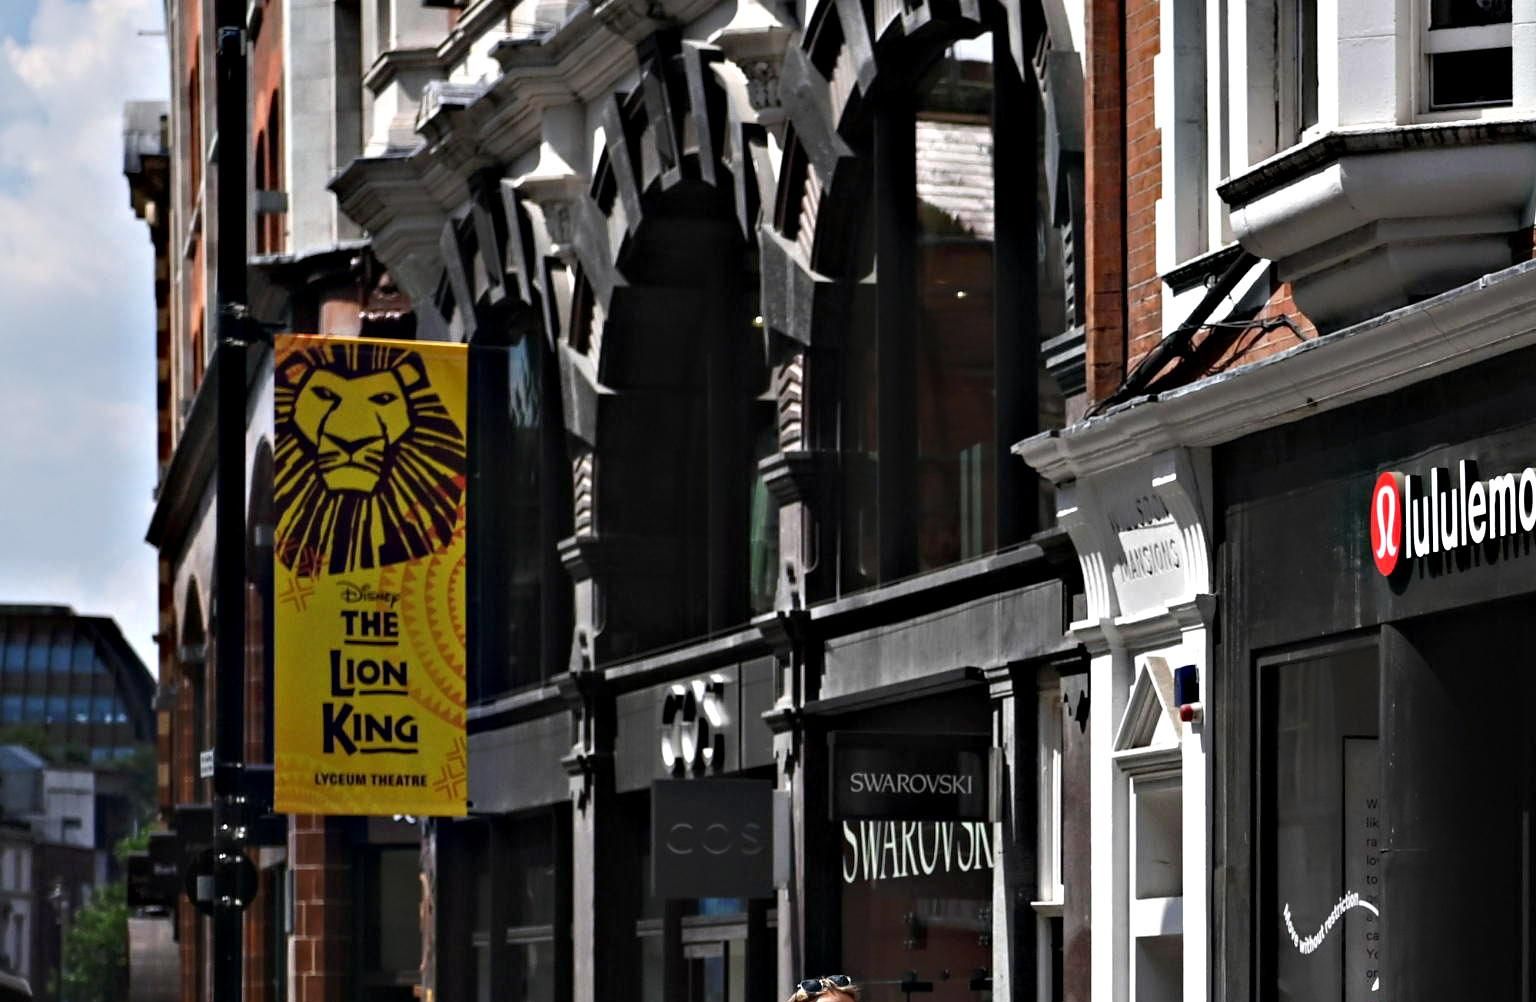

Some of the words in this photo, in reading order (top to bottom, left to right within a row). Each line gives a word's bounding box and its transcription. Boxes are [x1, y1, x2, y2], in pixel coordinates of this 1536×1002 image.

[336, 579, 399, 608] Disney
[341, 610, 399, 637] THE
[314, 773, 367, 786] LYCEUM
[371, 773, 428, 787] THEATRE
[850, 772, 973, 795] SWAROVSKI
[666, 822, 765, 855] COS
